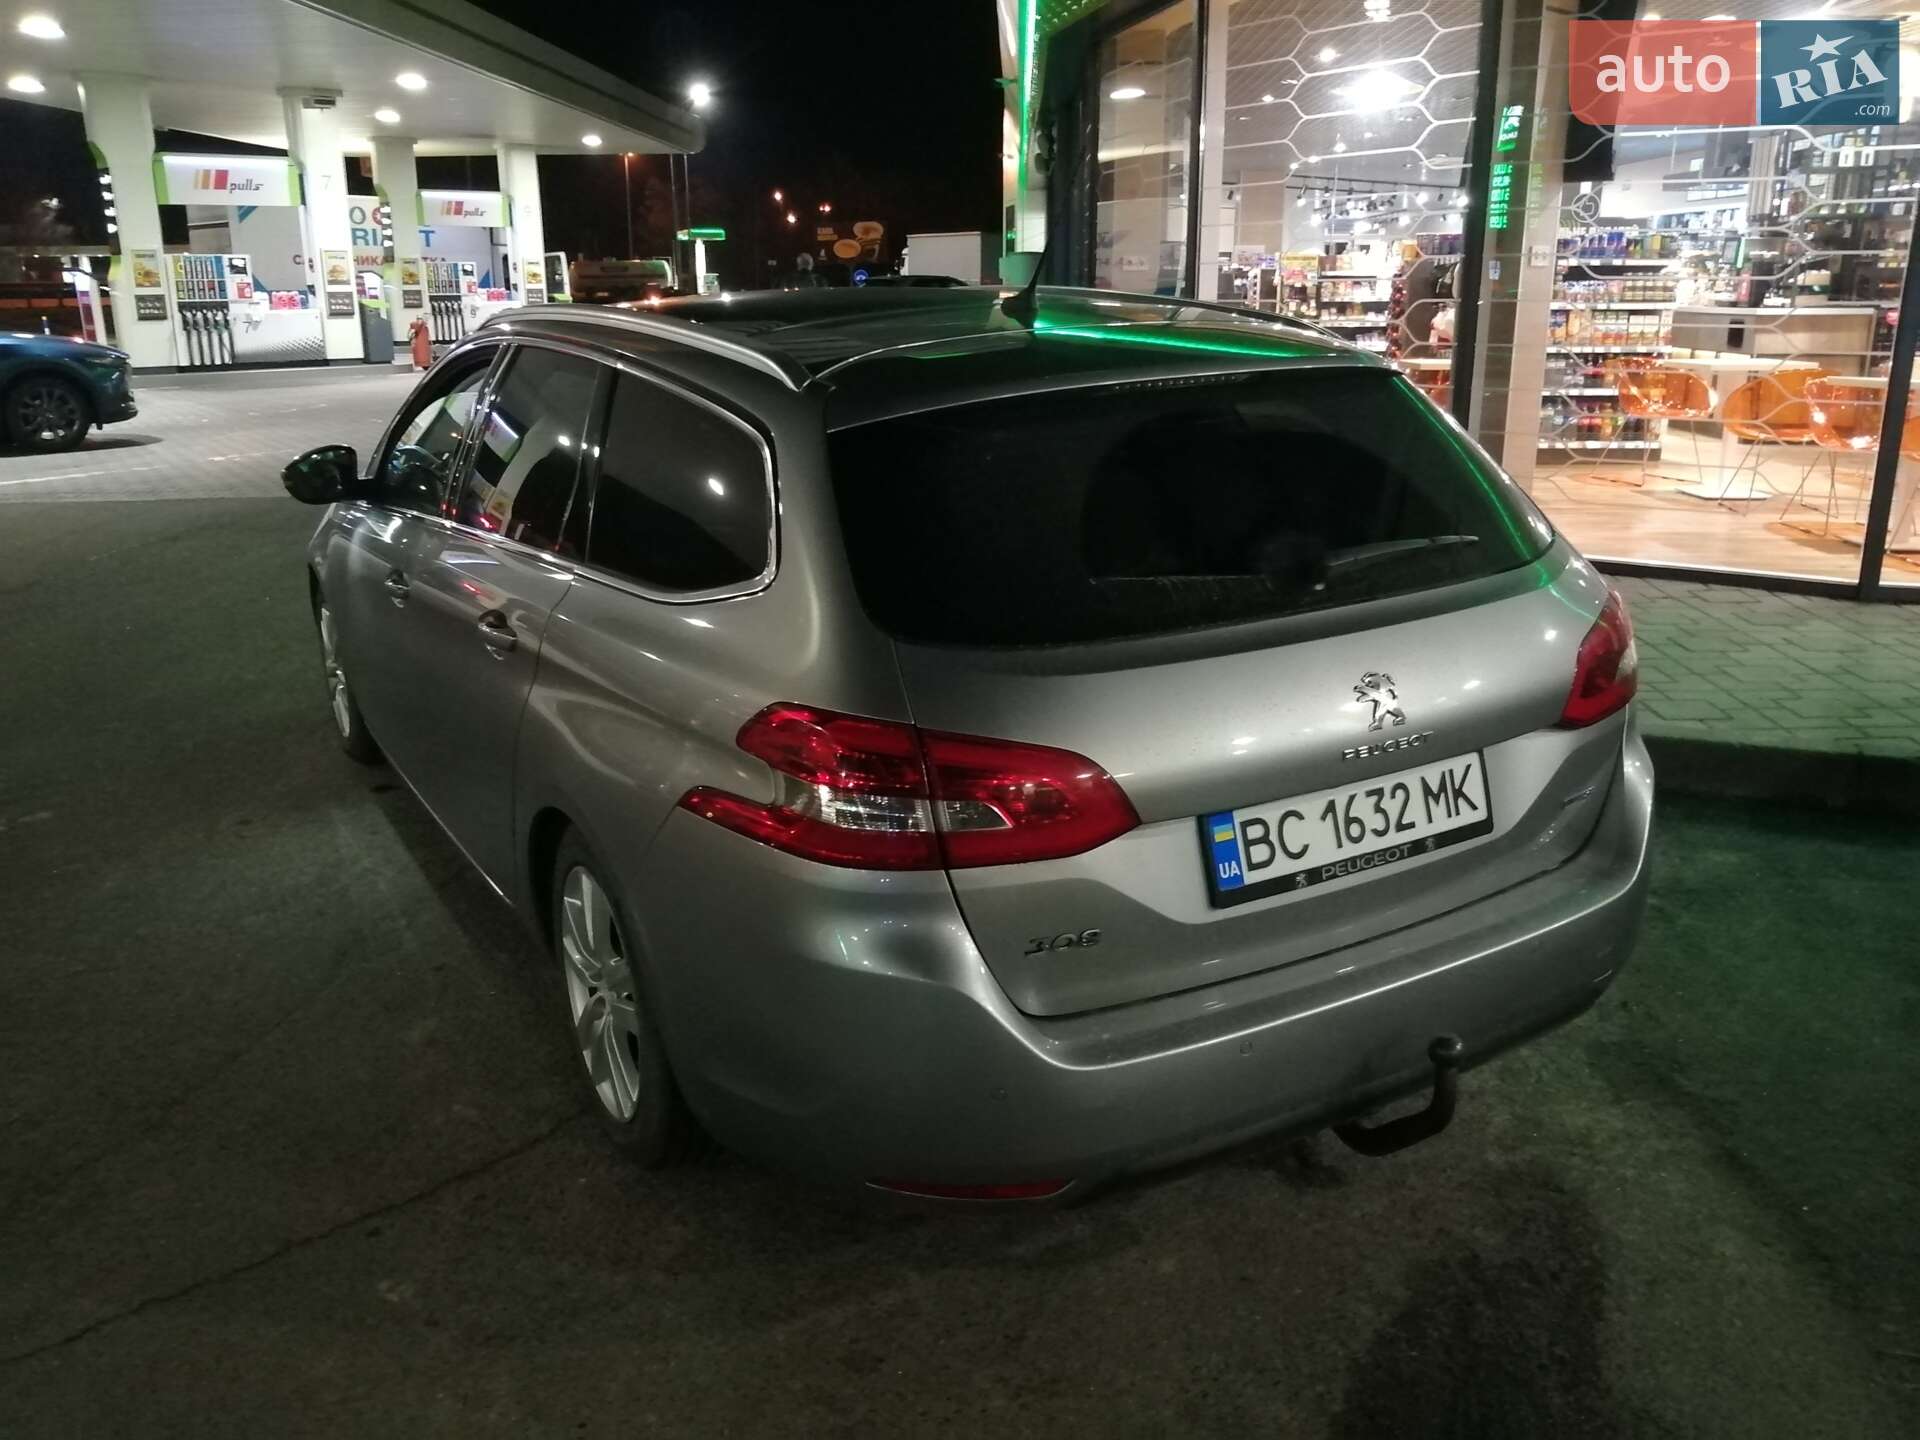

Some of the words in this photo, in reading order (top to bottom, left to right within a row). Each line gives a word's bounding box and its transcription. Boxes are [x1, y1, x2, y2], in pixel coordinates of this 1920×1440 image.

[1342, 731, 1434, 761] PEUGEOT
[1240, 809, 1309, 872] BC
[1320, 782, 1416, 850] 1632
[1420, 763, 1478, 824] MK
[1219, 861, 1240, 879] UA
[1321, 844, 1412, 881] PEUGEOT
